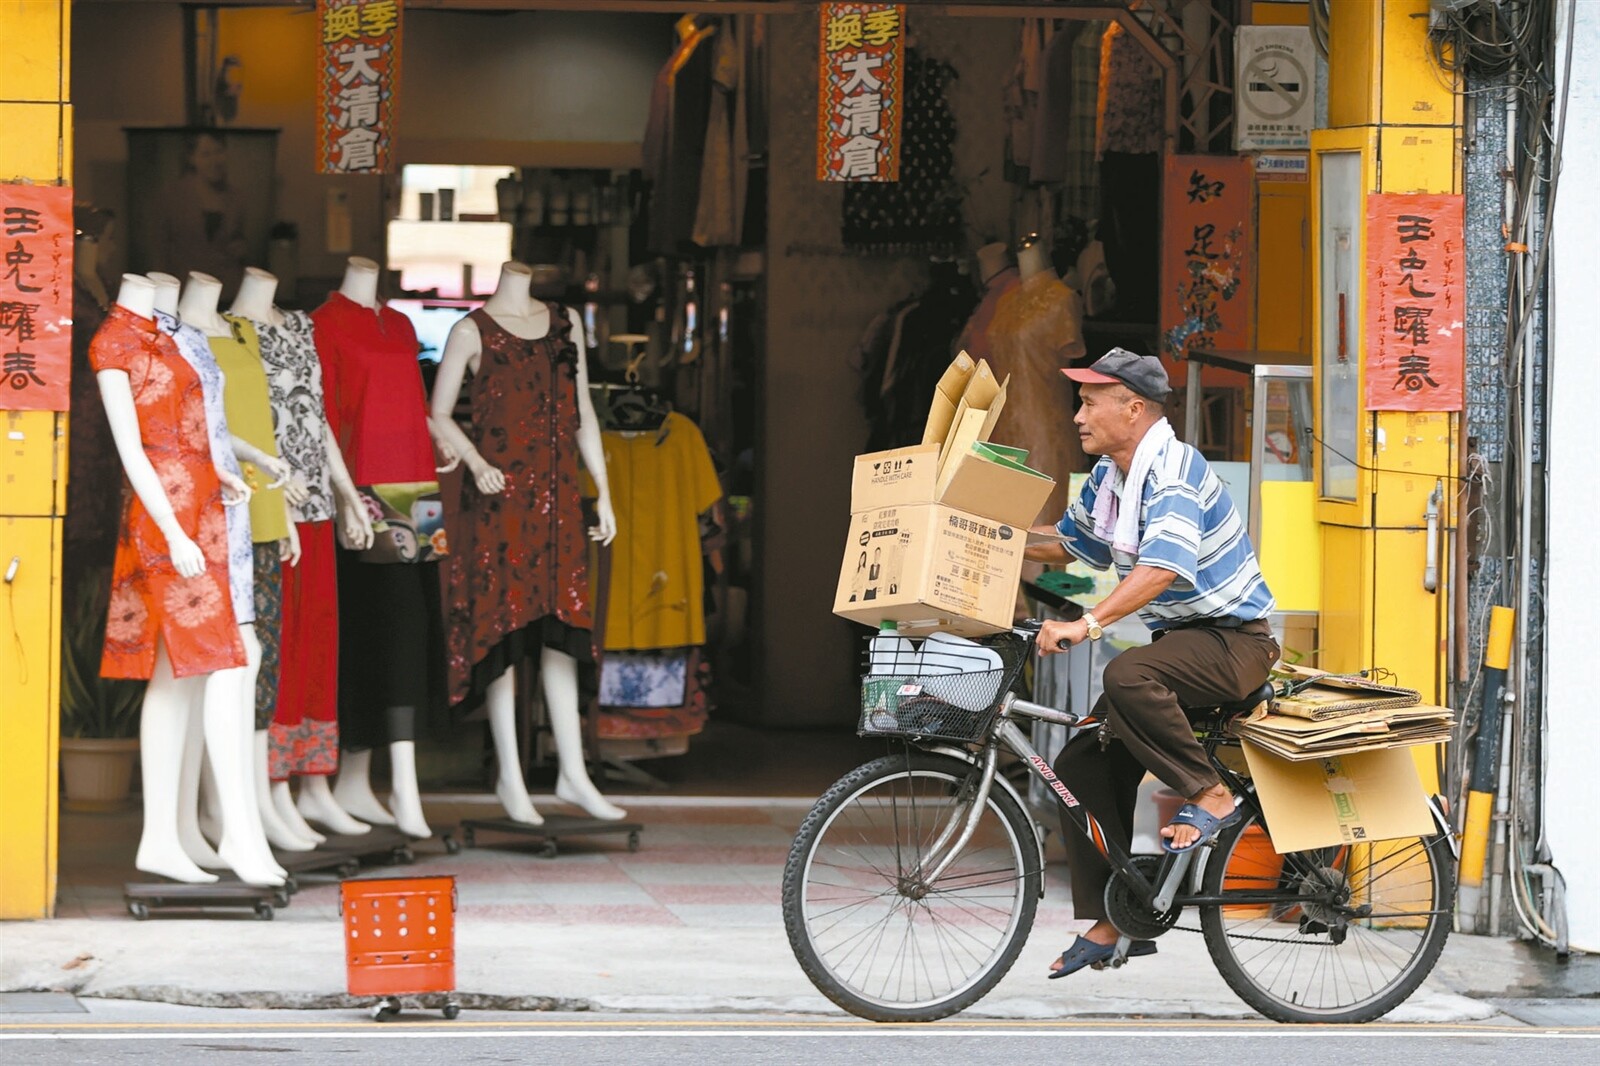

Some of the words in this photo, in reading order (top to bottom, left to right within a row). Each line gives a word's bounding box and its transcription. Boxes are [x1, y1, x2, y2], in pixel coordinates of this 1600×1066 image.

[323, 1, 398, 44] 換季
[826, 9, 900, 52] 換季
[337, 43, 381, 172] 大清倉
[839, 52, 883, 178] 大清倉
[871, 475, 888, 484] HANDLE
[889, 473, 900, 481] WITH
[901, 471, 913, 479] CARE
[1030, 755, 1056, 779] AND
[1052, 780, 1078, 806] BIKE
